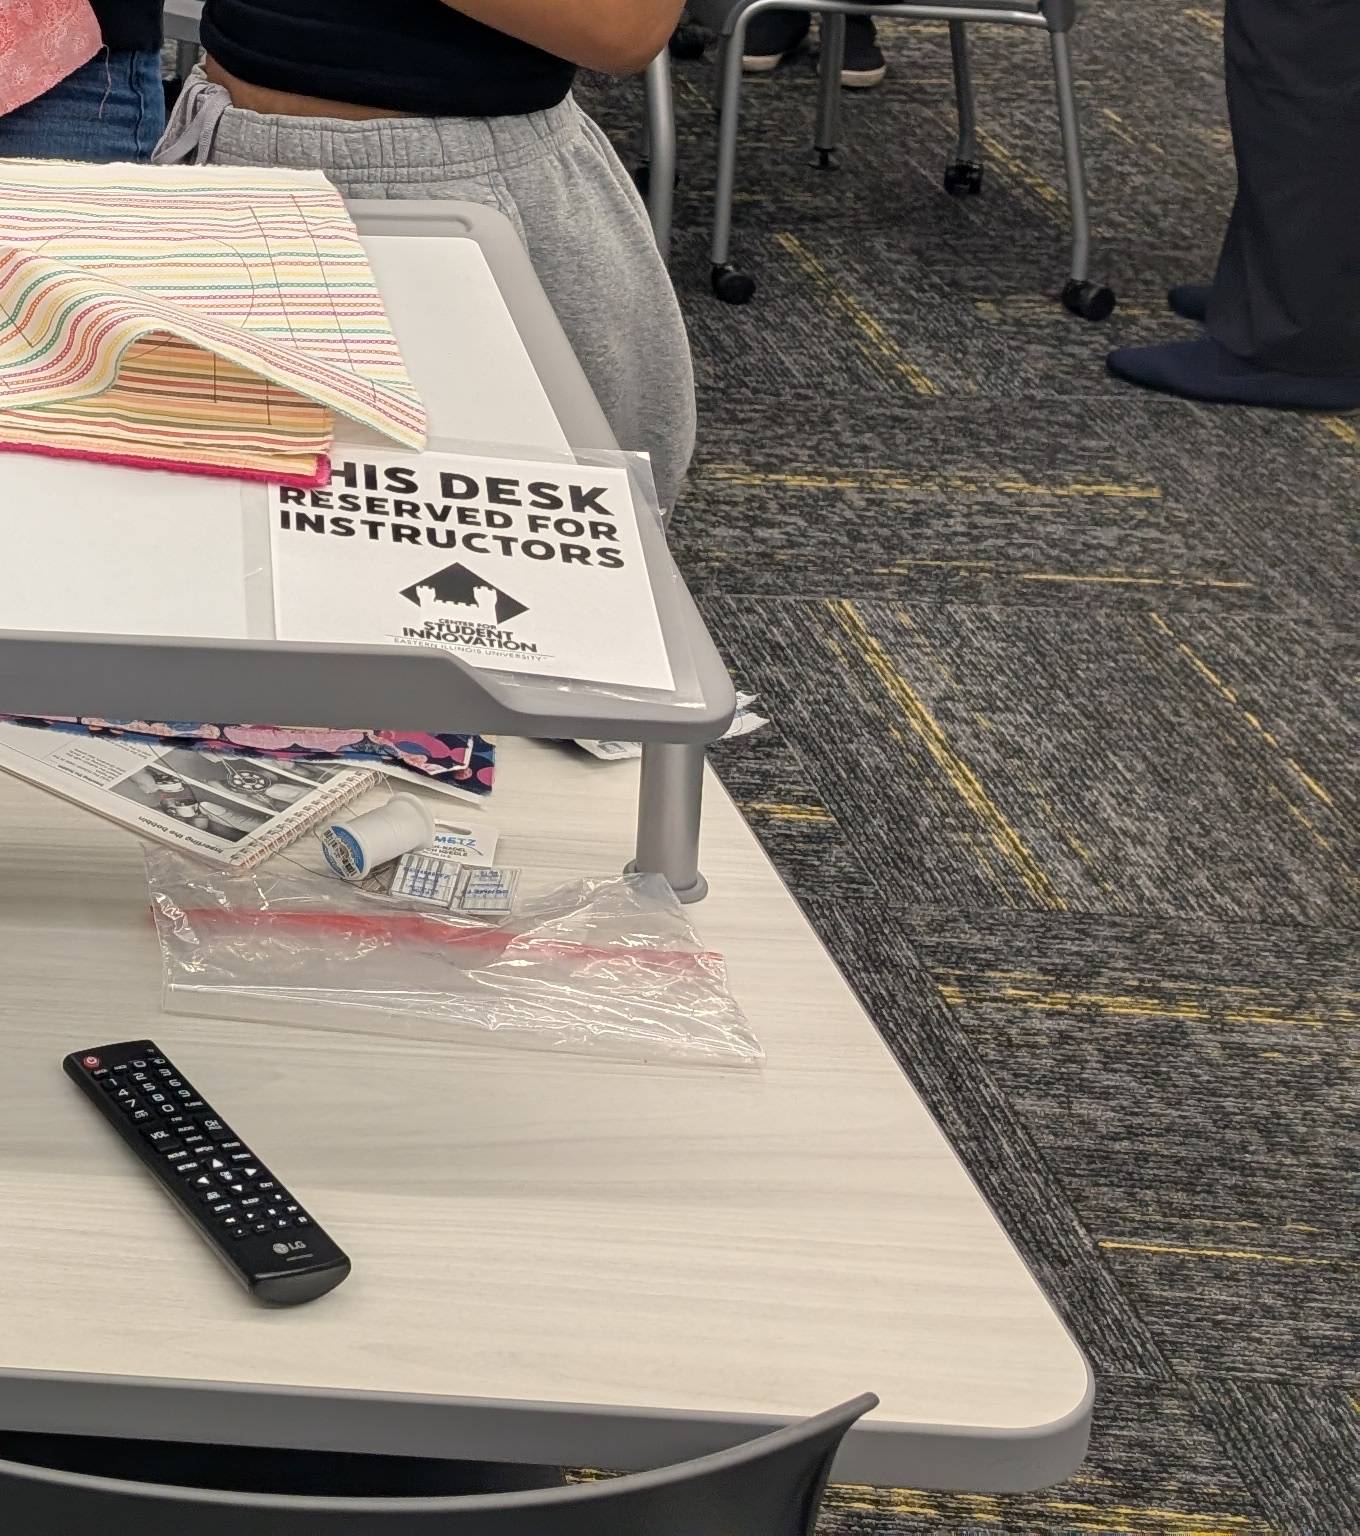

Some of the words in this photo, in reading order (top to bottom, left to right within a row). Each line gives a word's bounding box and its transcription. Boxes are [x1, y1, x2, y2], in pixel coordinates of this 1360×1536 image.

[331, 461, 418, 495] HIS
[440, 470, 615, 515] DESK
[279, 487, 514, 529] RESERVED
[528, 515, 620, 543] FOR
[279, 509, 626, 570] INSTRUCTORS
[424, 620, 514, 642] STUDENT
[438, 618, 474, 628] CENTER
[476, 622, 497, 630] FOR
[403, 627, 538, 653] INNOVATION
[441, 643, 482, 655] ILLINOIS
[138, 816, 169, 833] bobbin
[169, 830, 184, 839] the
[434, 835, 477, 847] METZ
[185, 836, 224, 854] Inserting
[108, 1078, 118, 1086] 1
[133, 1072, 147, 1081] 2
[159, 1069, 172, 1077] 3
[118, 1088, 129, 1096] 4
[142, 1083, 156, 1091] 5
[169, 1079, 181, 1087] 6
[125, 1098, 136, 1108] 7
[152, 1093, 164, 1102] 8
[178, 1089, 191, 1098] 9
[161, 1104, 174, 1113] 0
[150, 1130, 169, 1140] VOL
[287, 1240, 307, 1250] LG
